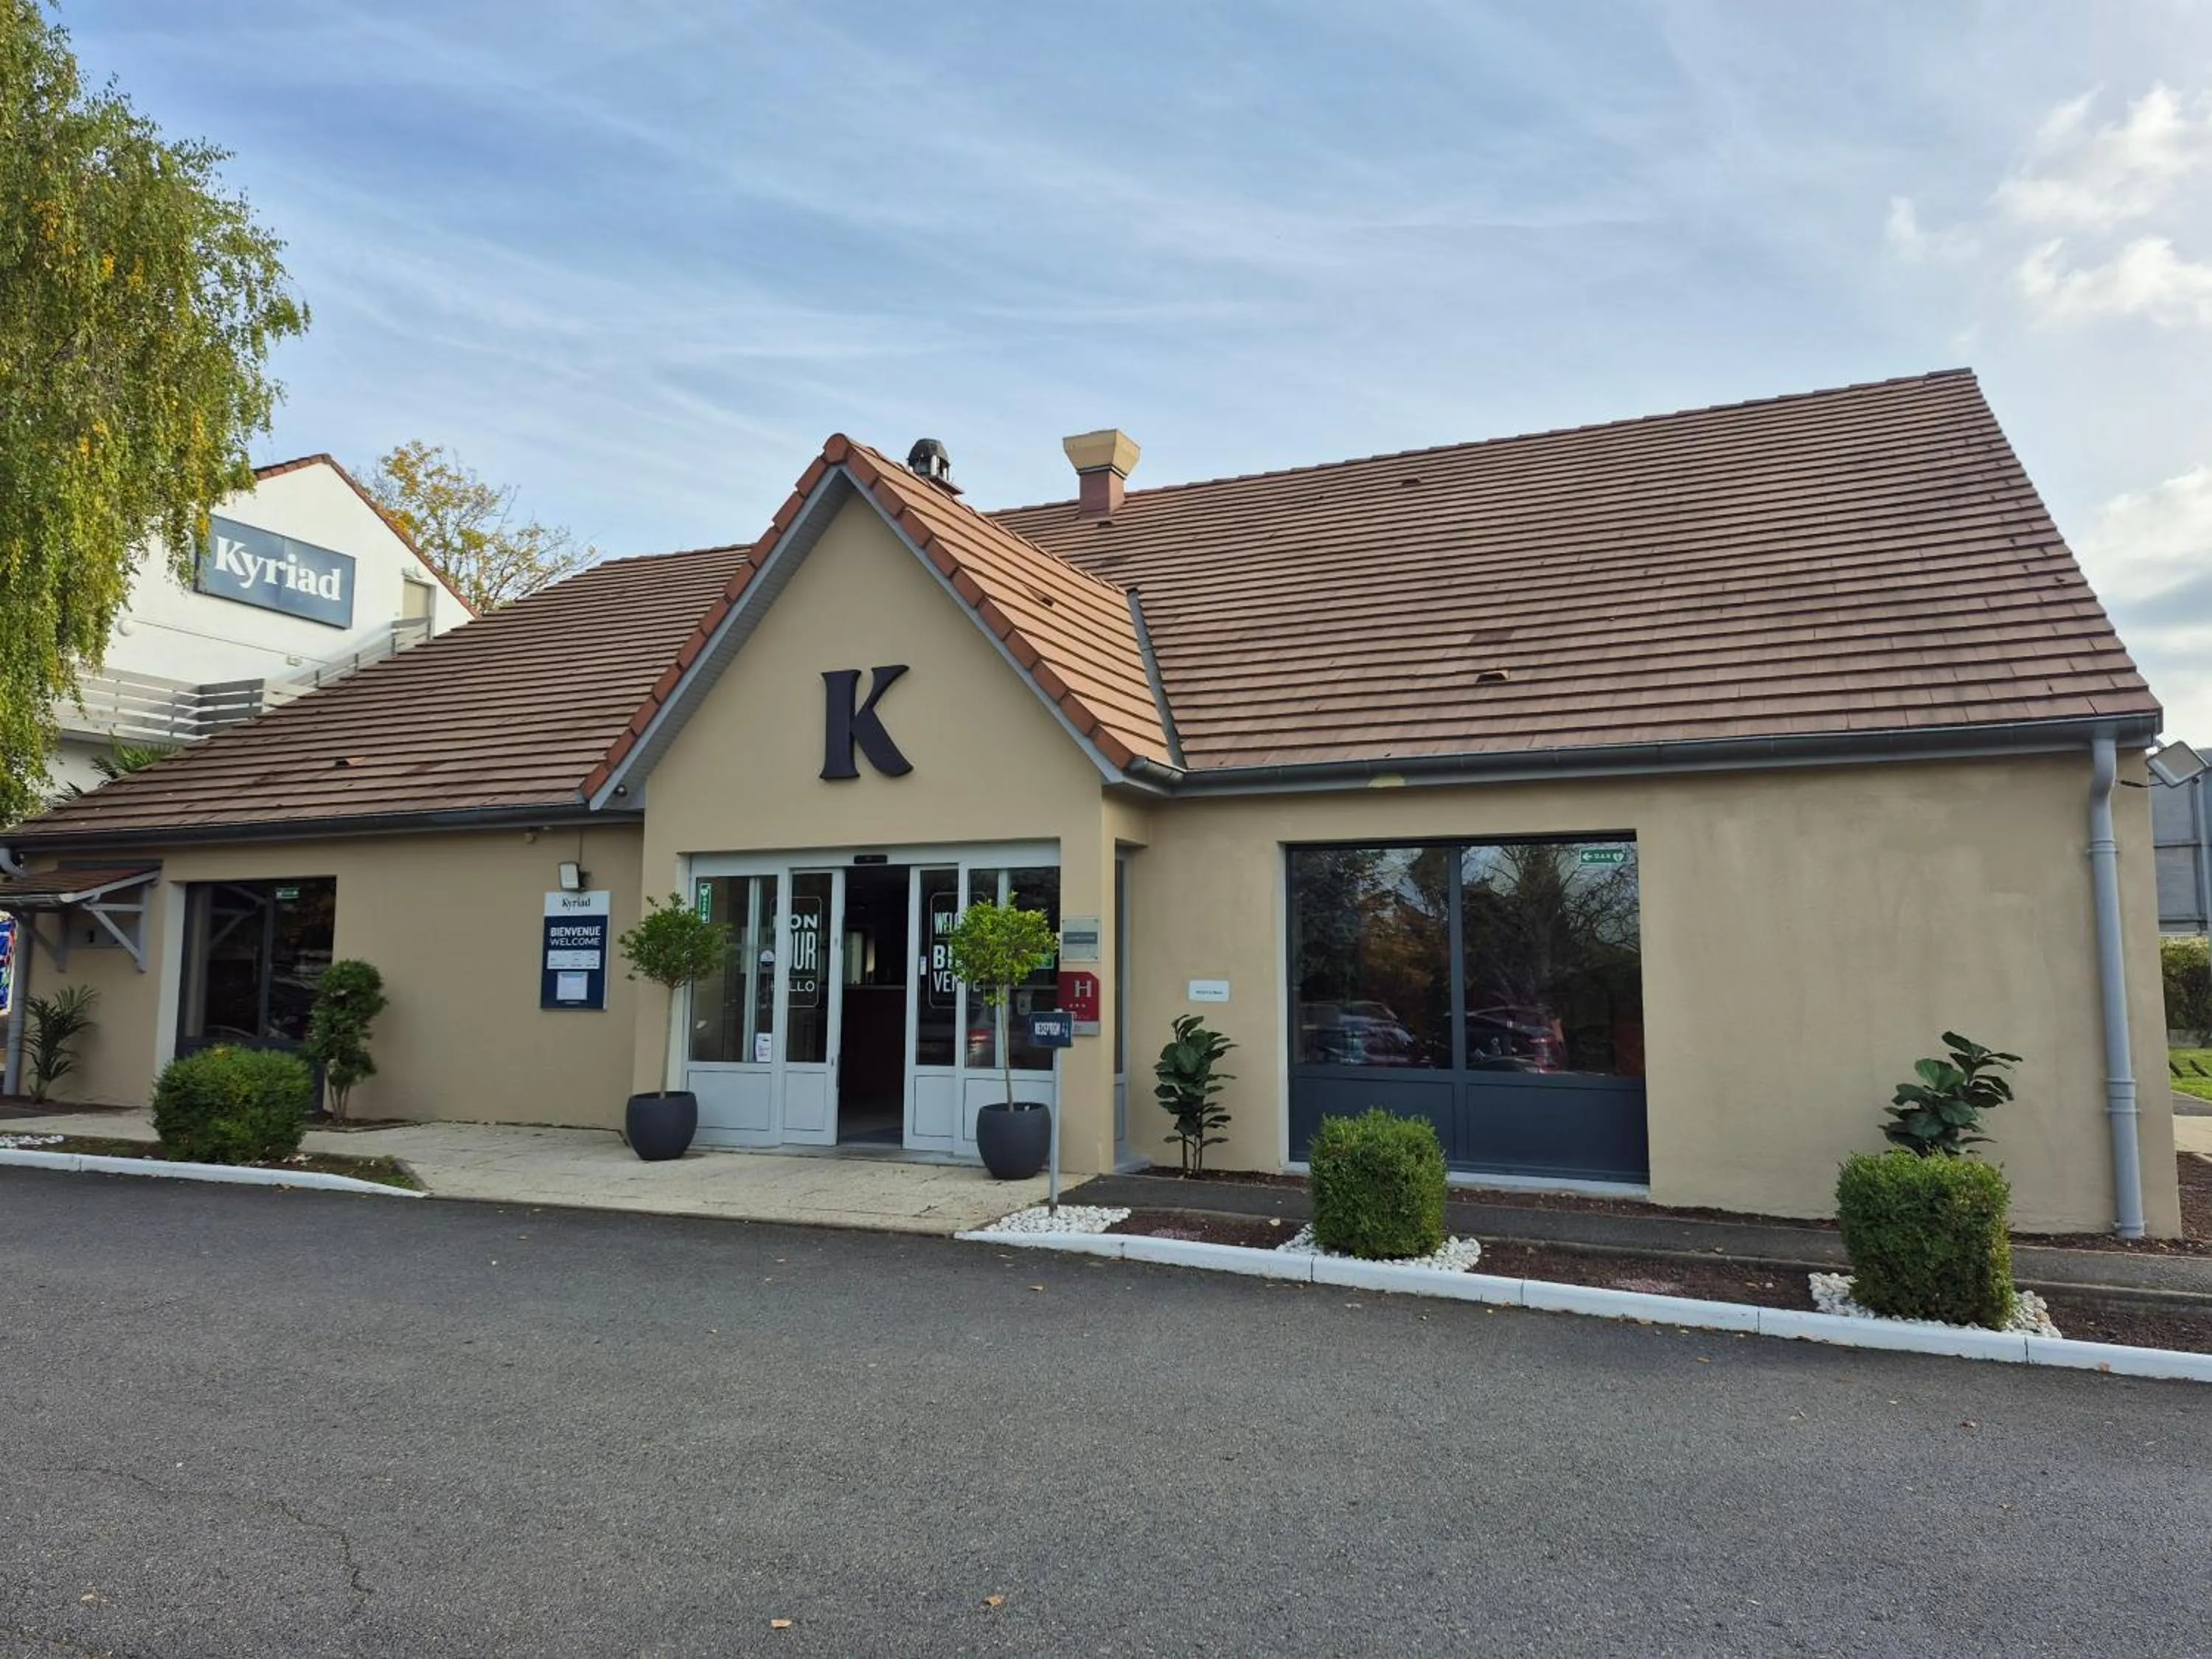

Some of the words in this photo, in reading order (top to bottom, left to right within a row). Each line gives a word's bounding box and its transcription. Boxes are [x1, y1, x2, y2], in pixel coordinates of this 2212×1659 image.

[215, 535, 342, 601] Kyriad
[819, 664, 914, 779] K
[562, 897, 591, 911] Kyriad
[773, 914, 818, 929] ON
[550, 925, 601, 937] BIENVENUE
[549, 936, 601, 947] WELCOME
[1074, 979, 1092, 998] H
